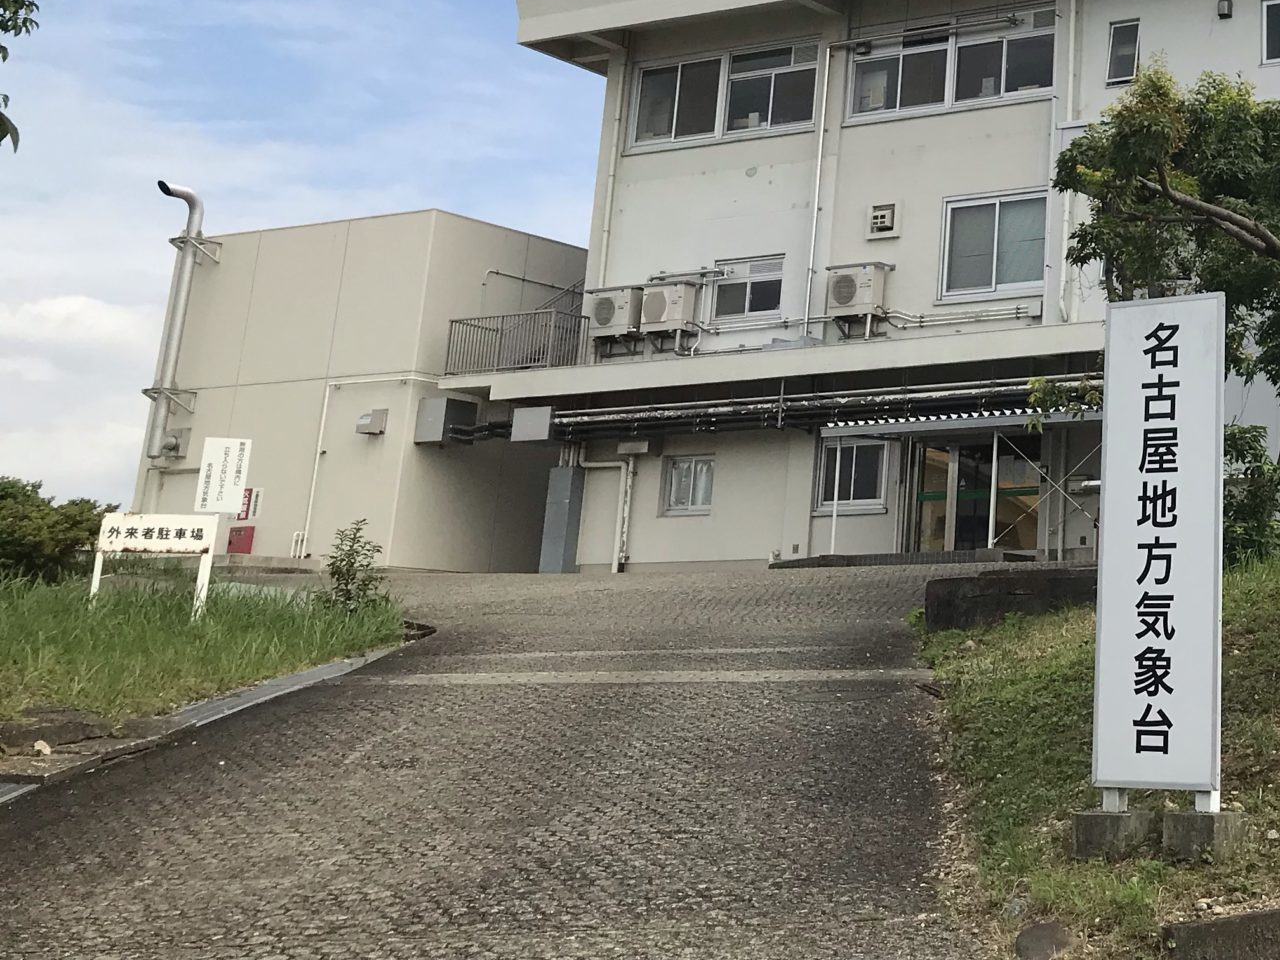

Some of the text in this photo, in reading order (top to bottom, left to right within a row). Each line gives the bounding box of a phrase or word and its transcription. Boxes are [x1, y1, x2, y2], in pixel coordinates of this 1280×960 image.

[107, 526, 205, 541] 外来者駐車場
[1132, 321, 1180, 756] 名古屋地方気象台
